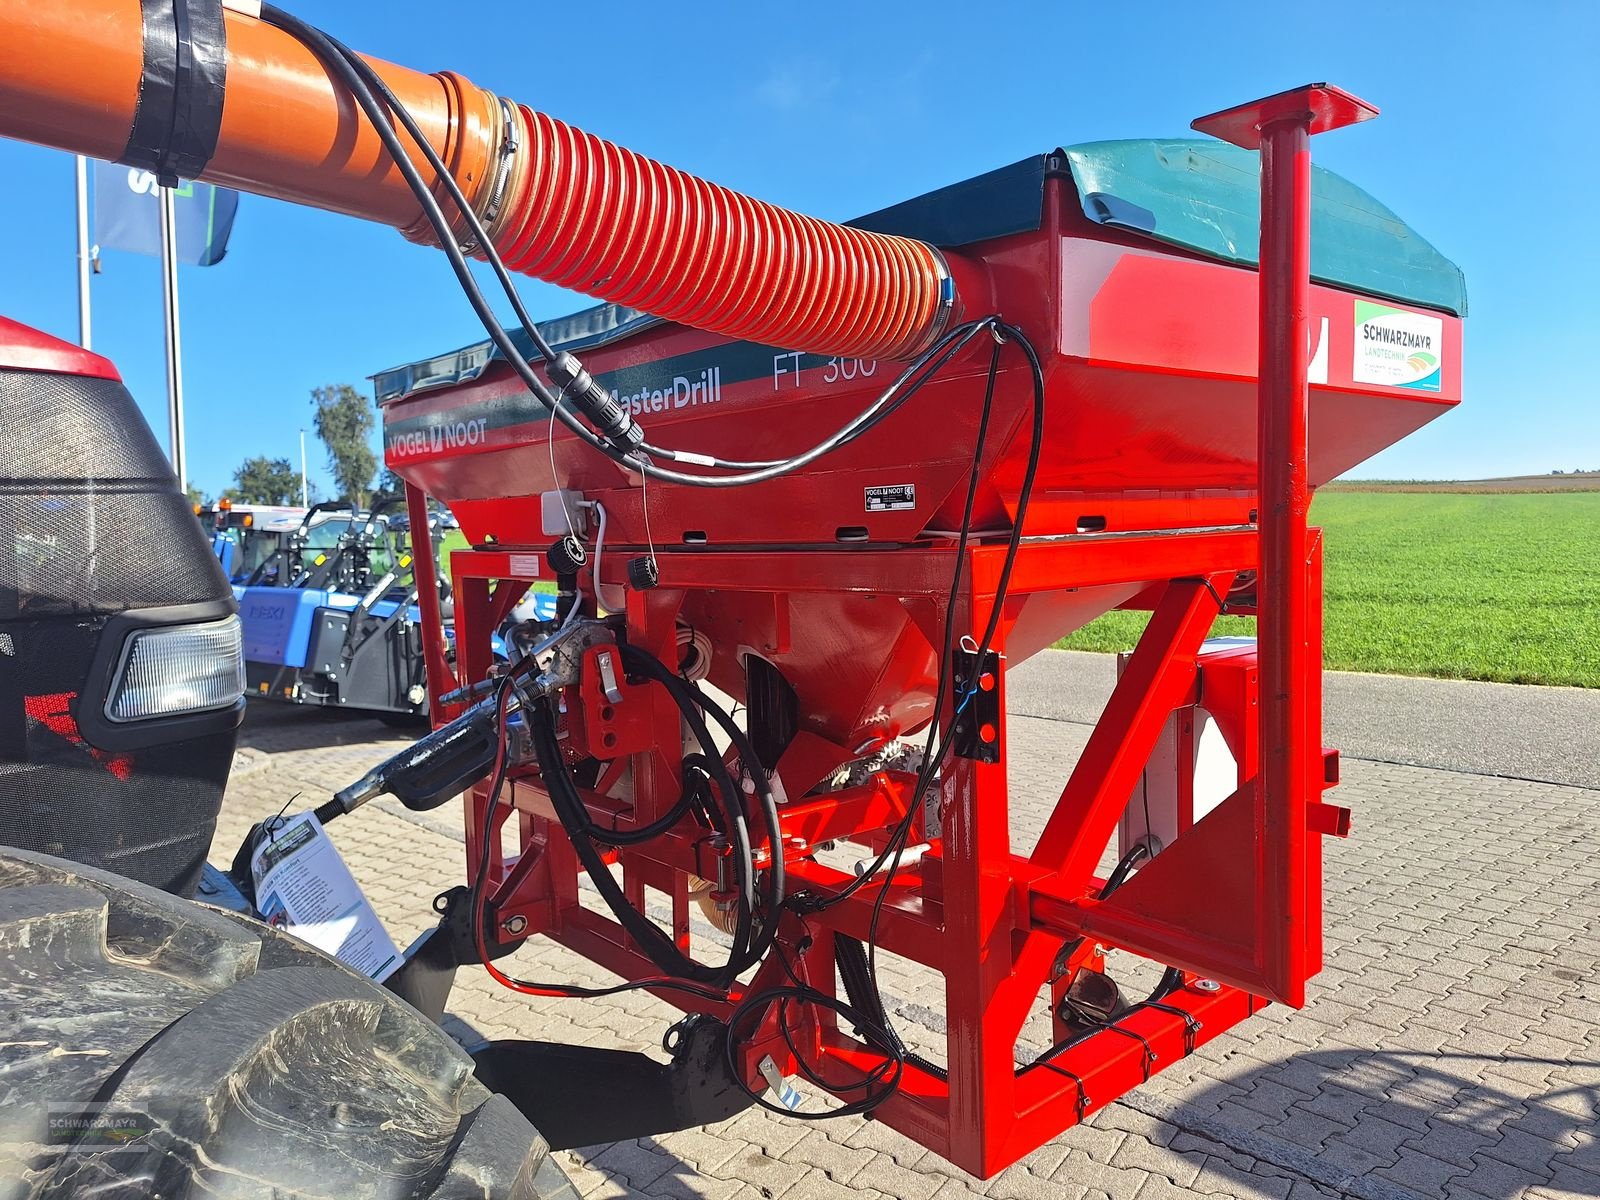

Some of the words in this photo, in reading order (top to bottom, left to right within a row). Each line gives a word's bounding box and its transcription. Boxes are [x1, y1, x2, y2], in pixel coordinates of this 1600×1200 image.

[1363, 323, 1431, 350] SCHWARZMAYR
[1364, 346, 1406, 361] LANDTECHNIK
[774, 352, 806, 390] FT
[388, 430, 431, 457] VOGEL
[445, 418, 487, 448] NOOT
